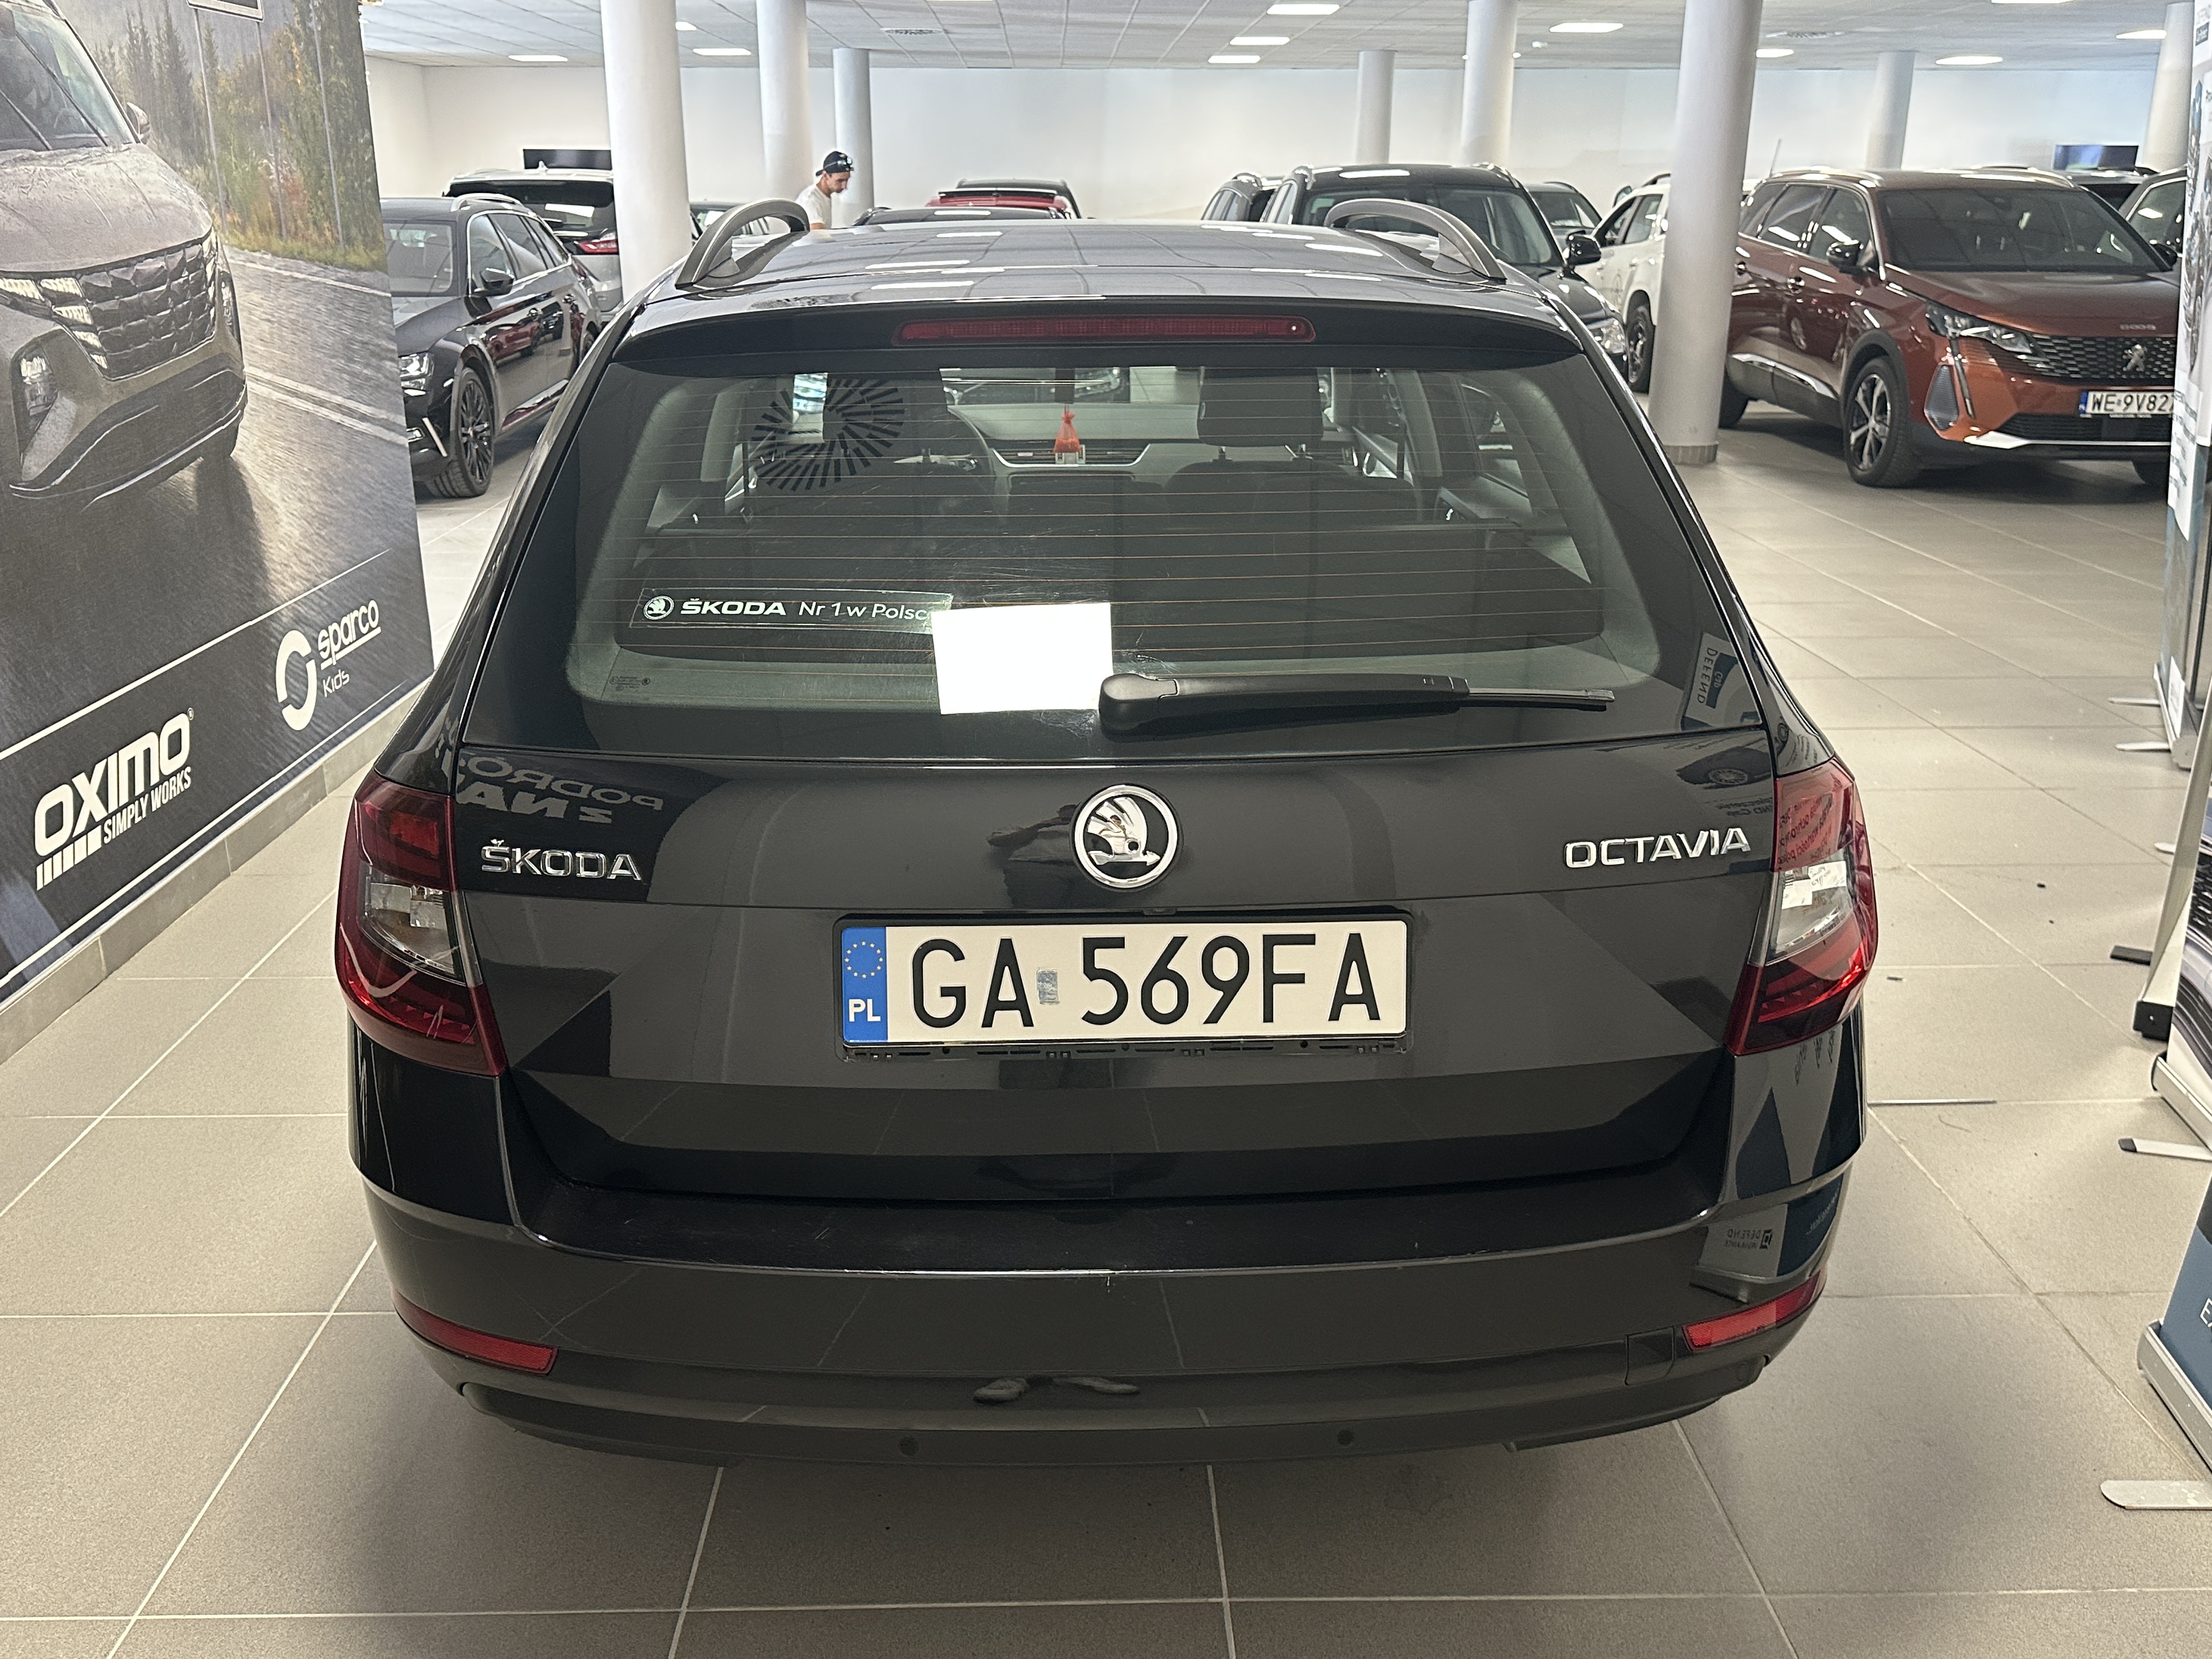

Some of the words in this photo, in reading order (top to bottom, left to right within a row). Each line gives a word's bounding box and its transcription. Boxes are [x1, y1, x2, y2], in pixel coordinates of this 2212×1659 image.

[2092, 393, 2116, 411] WE
[653, 599, 786, 615] ŠKODA
[799, 602, 825, 616] Nr
[831, 603, 841, 617] 1
[846, 606, 867, 617] w
[872, 604, 928, 620] Polsc
[318, 600, 379, 665] sparco
[323, 669, 349, 698] Kids
[103, 793, 149, 844] SIMPLY
[150, 766, 191, 811] WORKS
[481, 839, 642, 881] ŠKODA
[1565, 828, 1751, 868] OCTAVIA
[911, 937, 1035, 1029] GA
[1081, 932, 1381, 1025] 569FA
[848, 998, 881, 1022] PL
